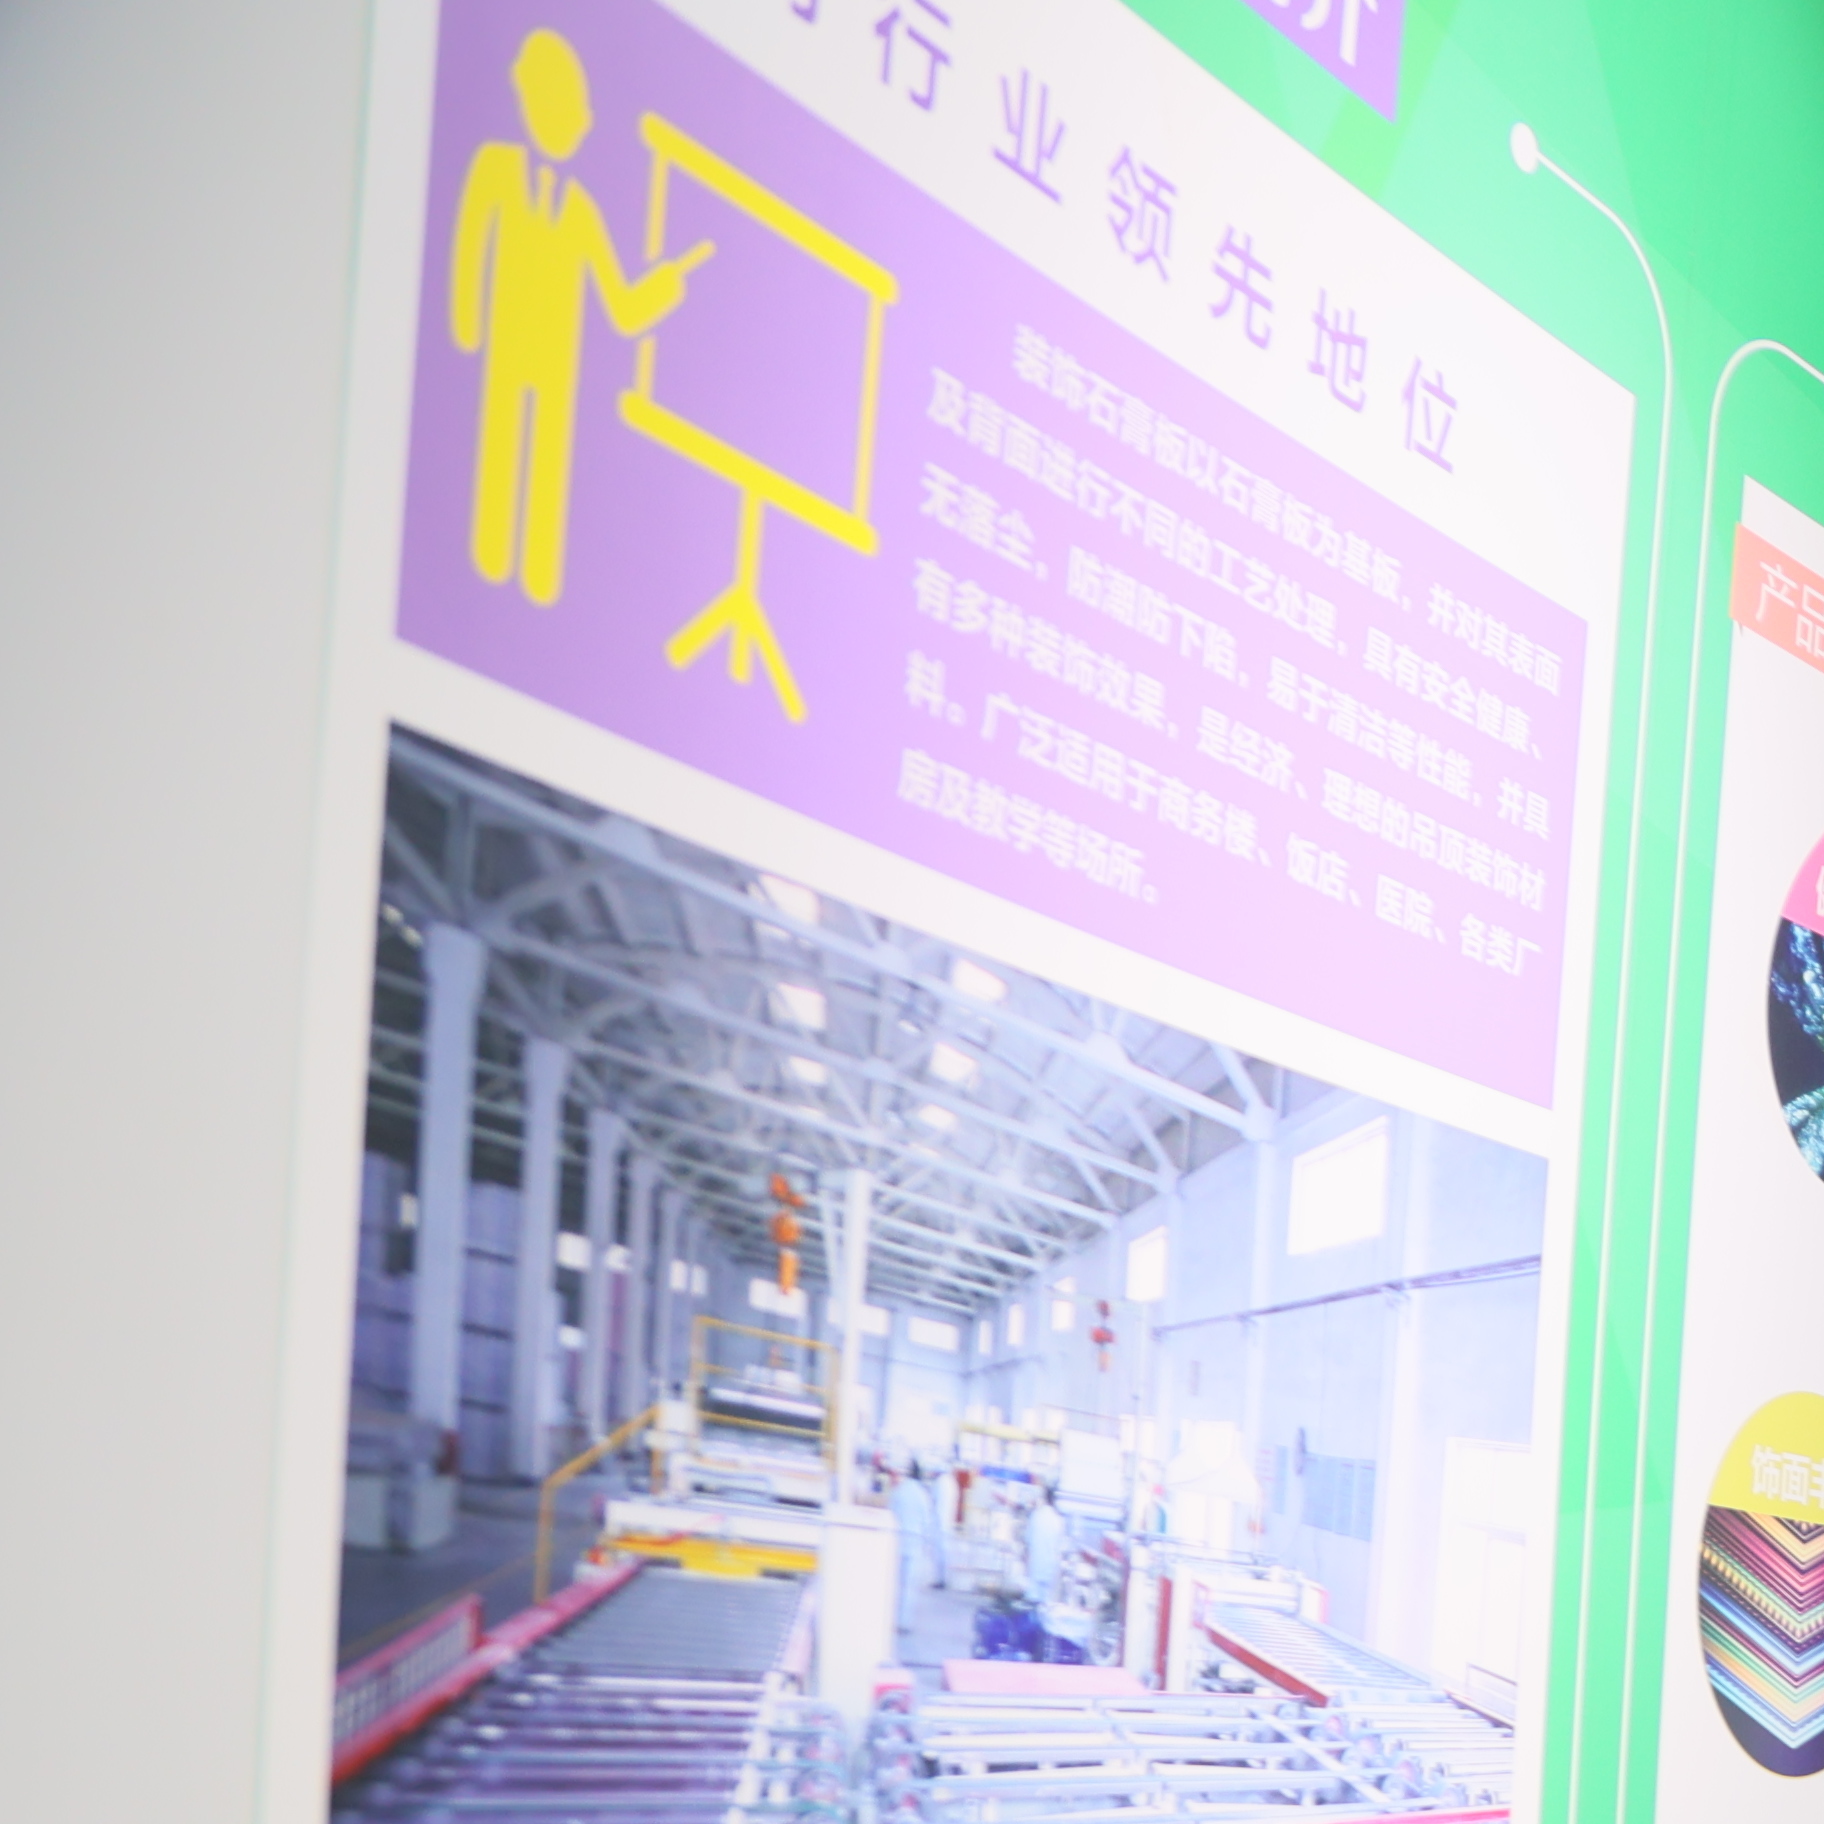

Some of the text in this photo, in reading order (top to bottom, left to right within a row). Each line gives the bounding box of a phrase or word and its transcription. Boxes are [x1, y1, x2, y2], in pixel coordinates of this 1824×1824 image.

[790, 0, 1458, 475] 行业领先地位
